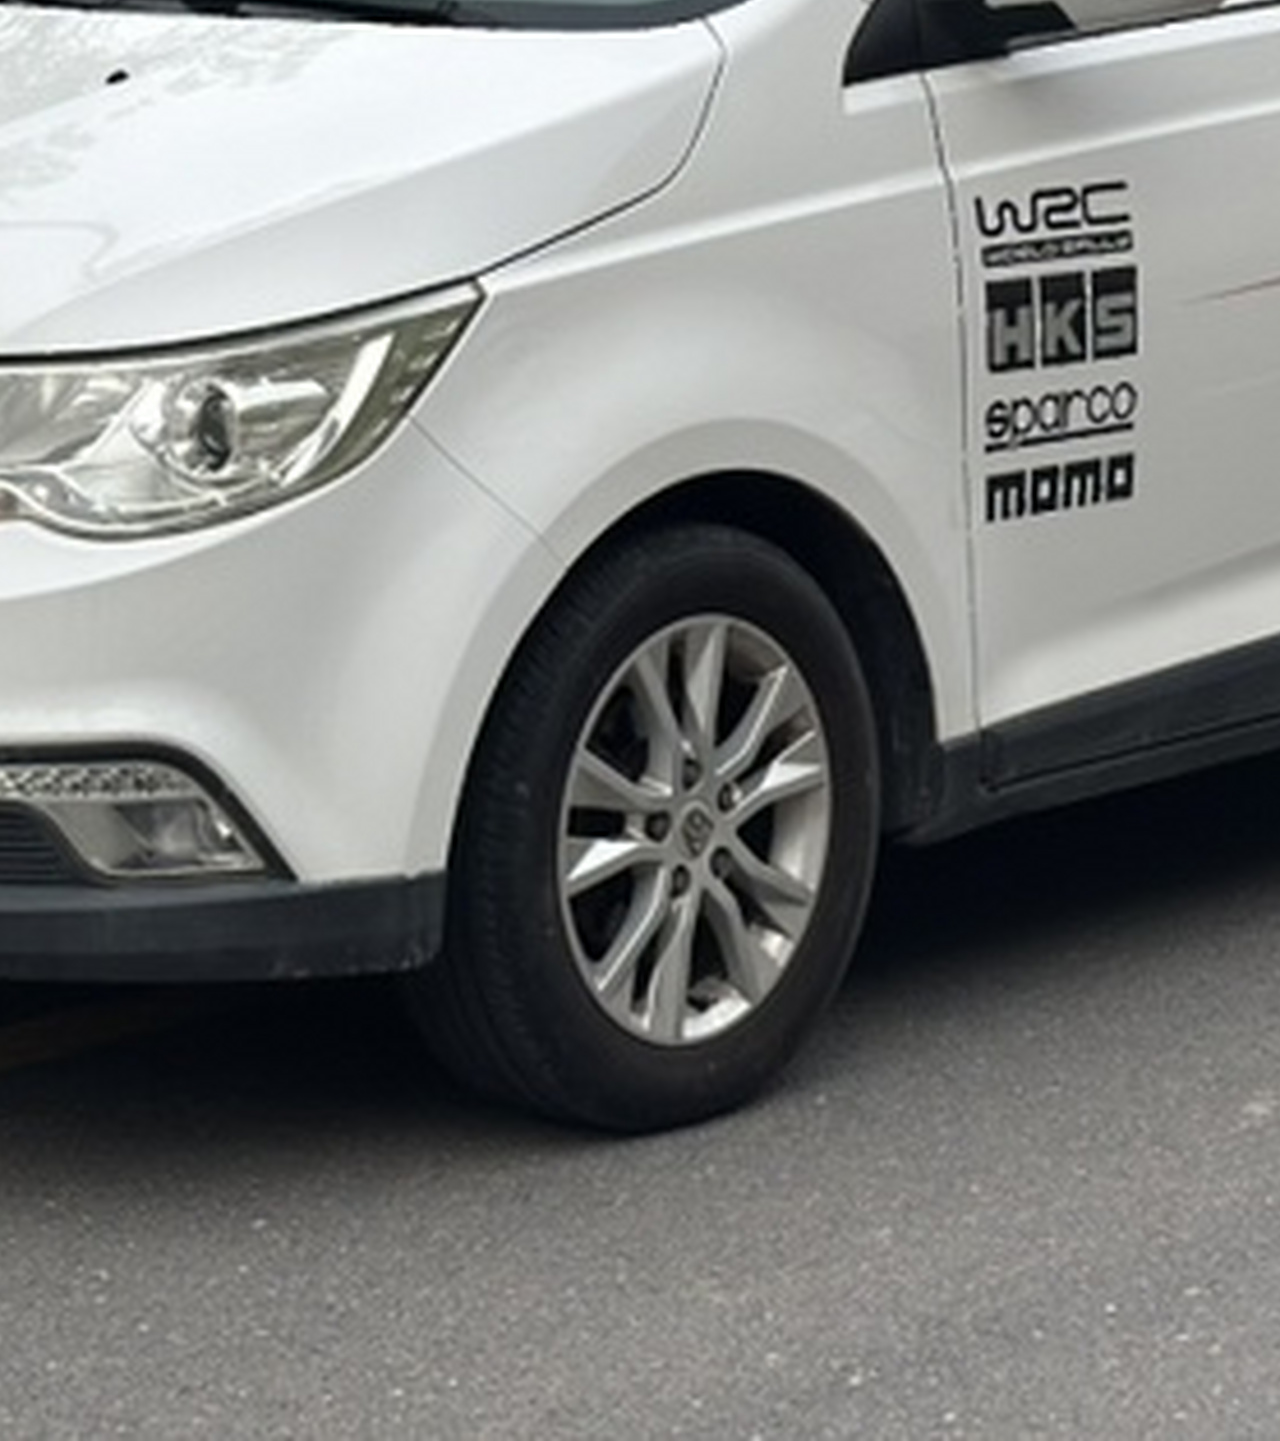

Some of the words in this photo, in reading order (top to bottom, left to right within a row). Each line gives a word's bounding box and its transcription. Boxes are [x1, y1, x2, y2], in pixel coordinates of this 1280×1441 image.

[975, 181, 1131, 237] WRC
[988, 288, 1137, 368] HKS
[985, 381, 1138, 447] sparco
